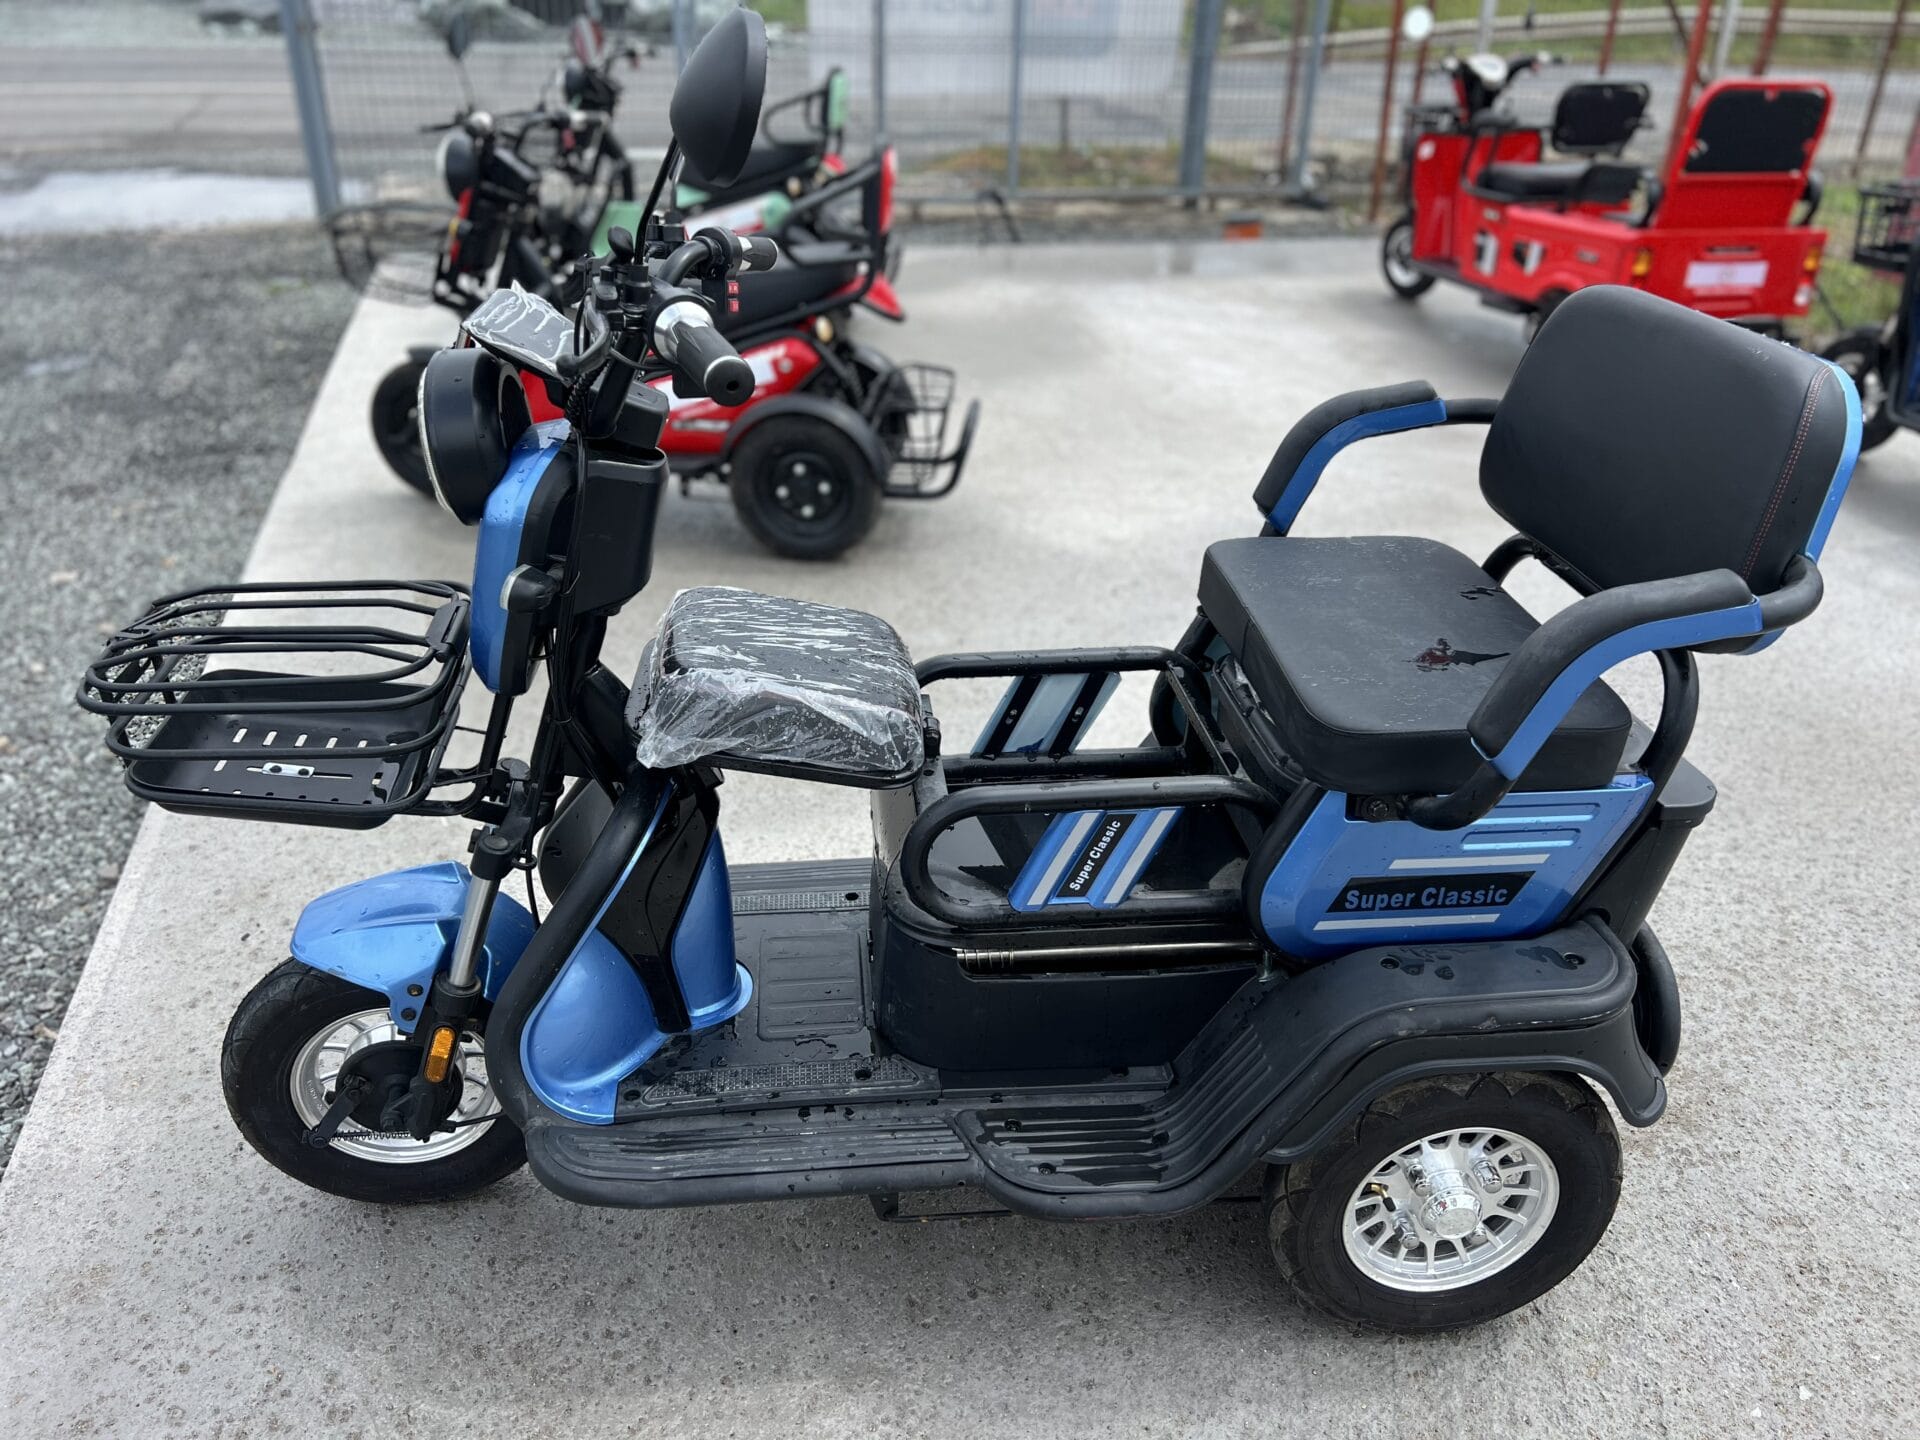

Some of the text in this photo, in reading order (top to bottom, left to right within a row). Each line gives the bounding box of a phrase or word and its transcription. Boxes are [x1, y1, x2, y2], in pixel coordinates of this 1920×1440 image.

[1069, 820, 1121, 891] Super Classic
[1345, 885, 1508, 911] Super Classic
